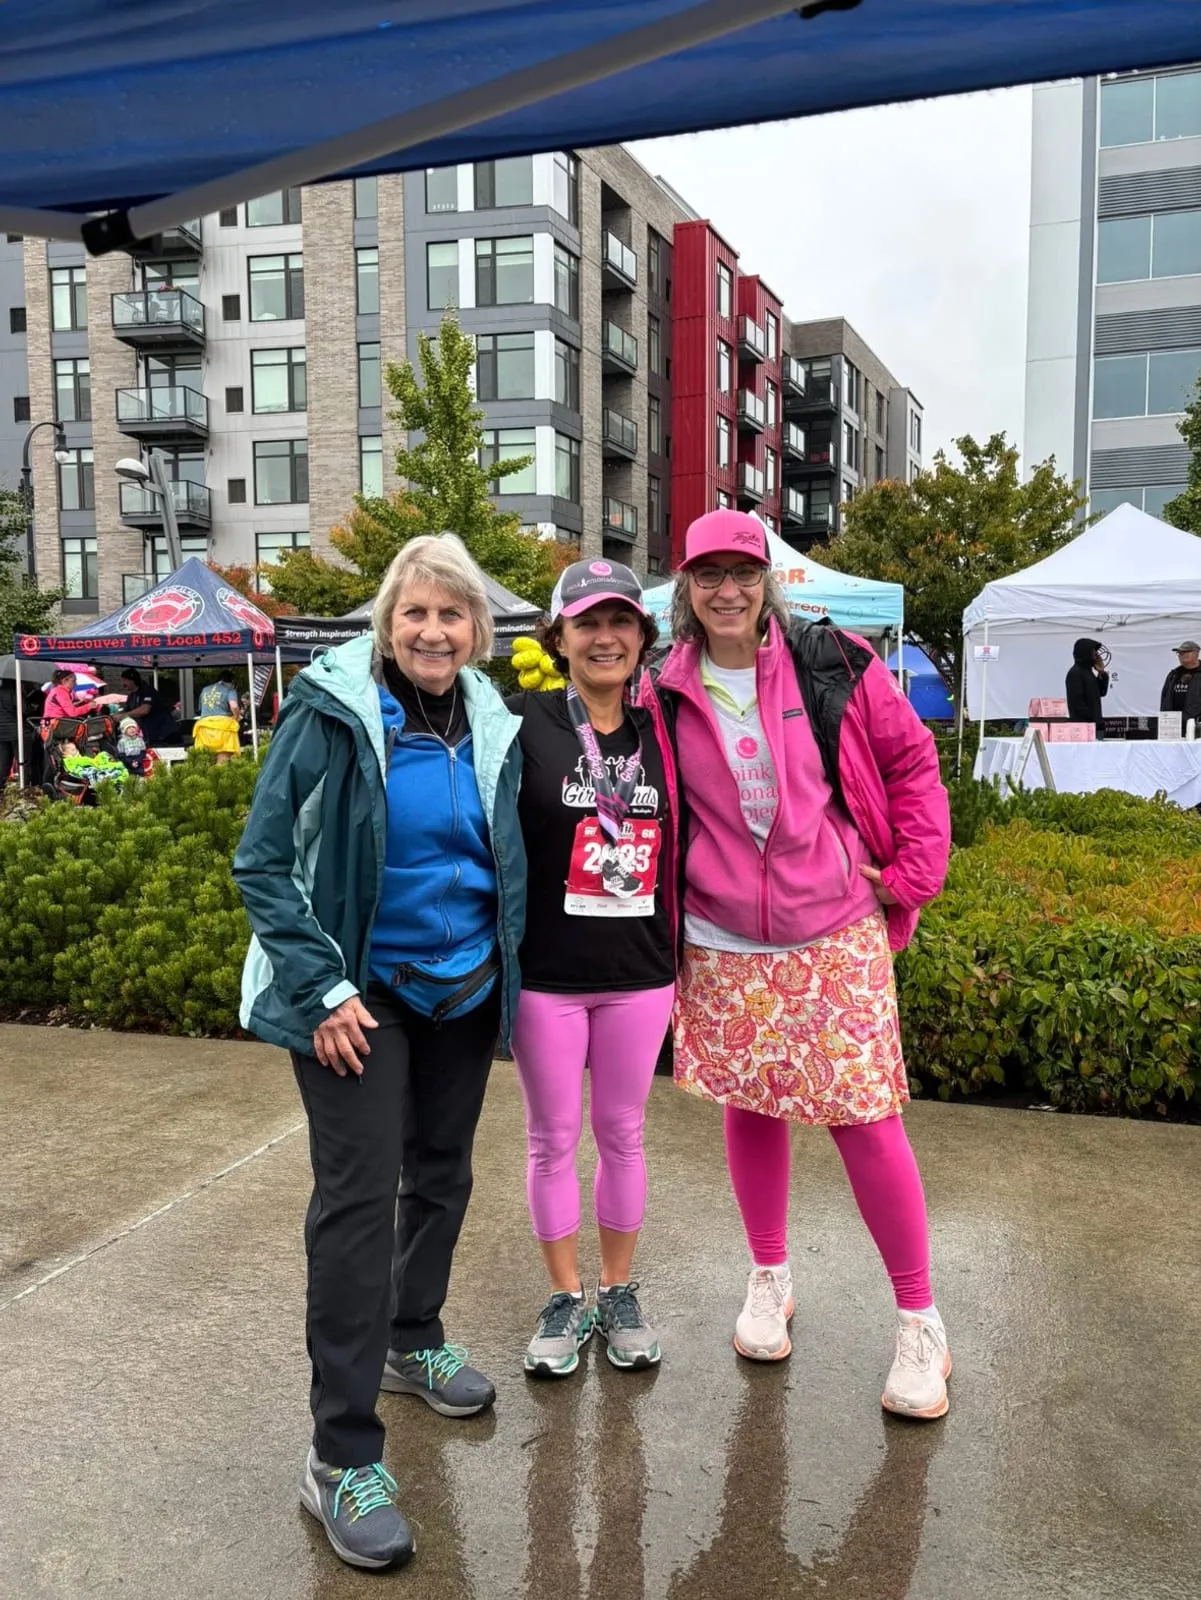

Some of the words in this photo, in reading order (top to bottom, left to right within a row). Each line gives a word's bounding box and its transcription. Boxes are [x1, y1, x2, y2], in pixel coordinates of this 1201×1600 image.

[46, 638, 126, 650] Vancouver
[131, 634, 161, 647] Fire
[166, 632, 207, 646] Local
[211, 631, 242, 645] 452
[285, 630, 318, 639] Strength
[319, 629, 361, 639] Inspiration
